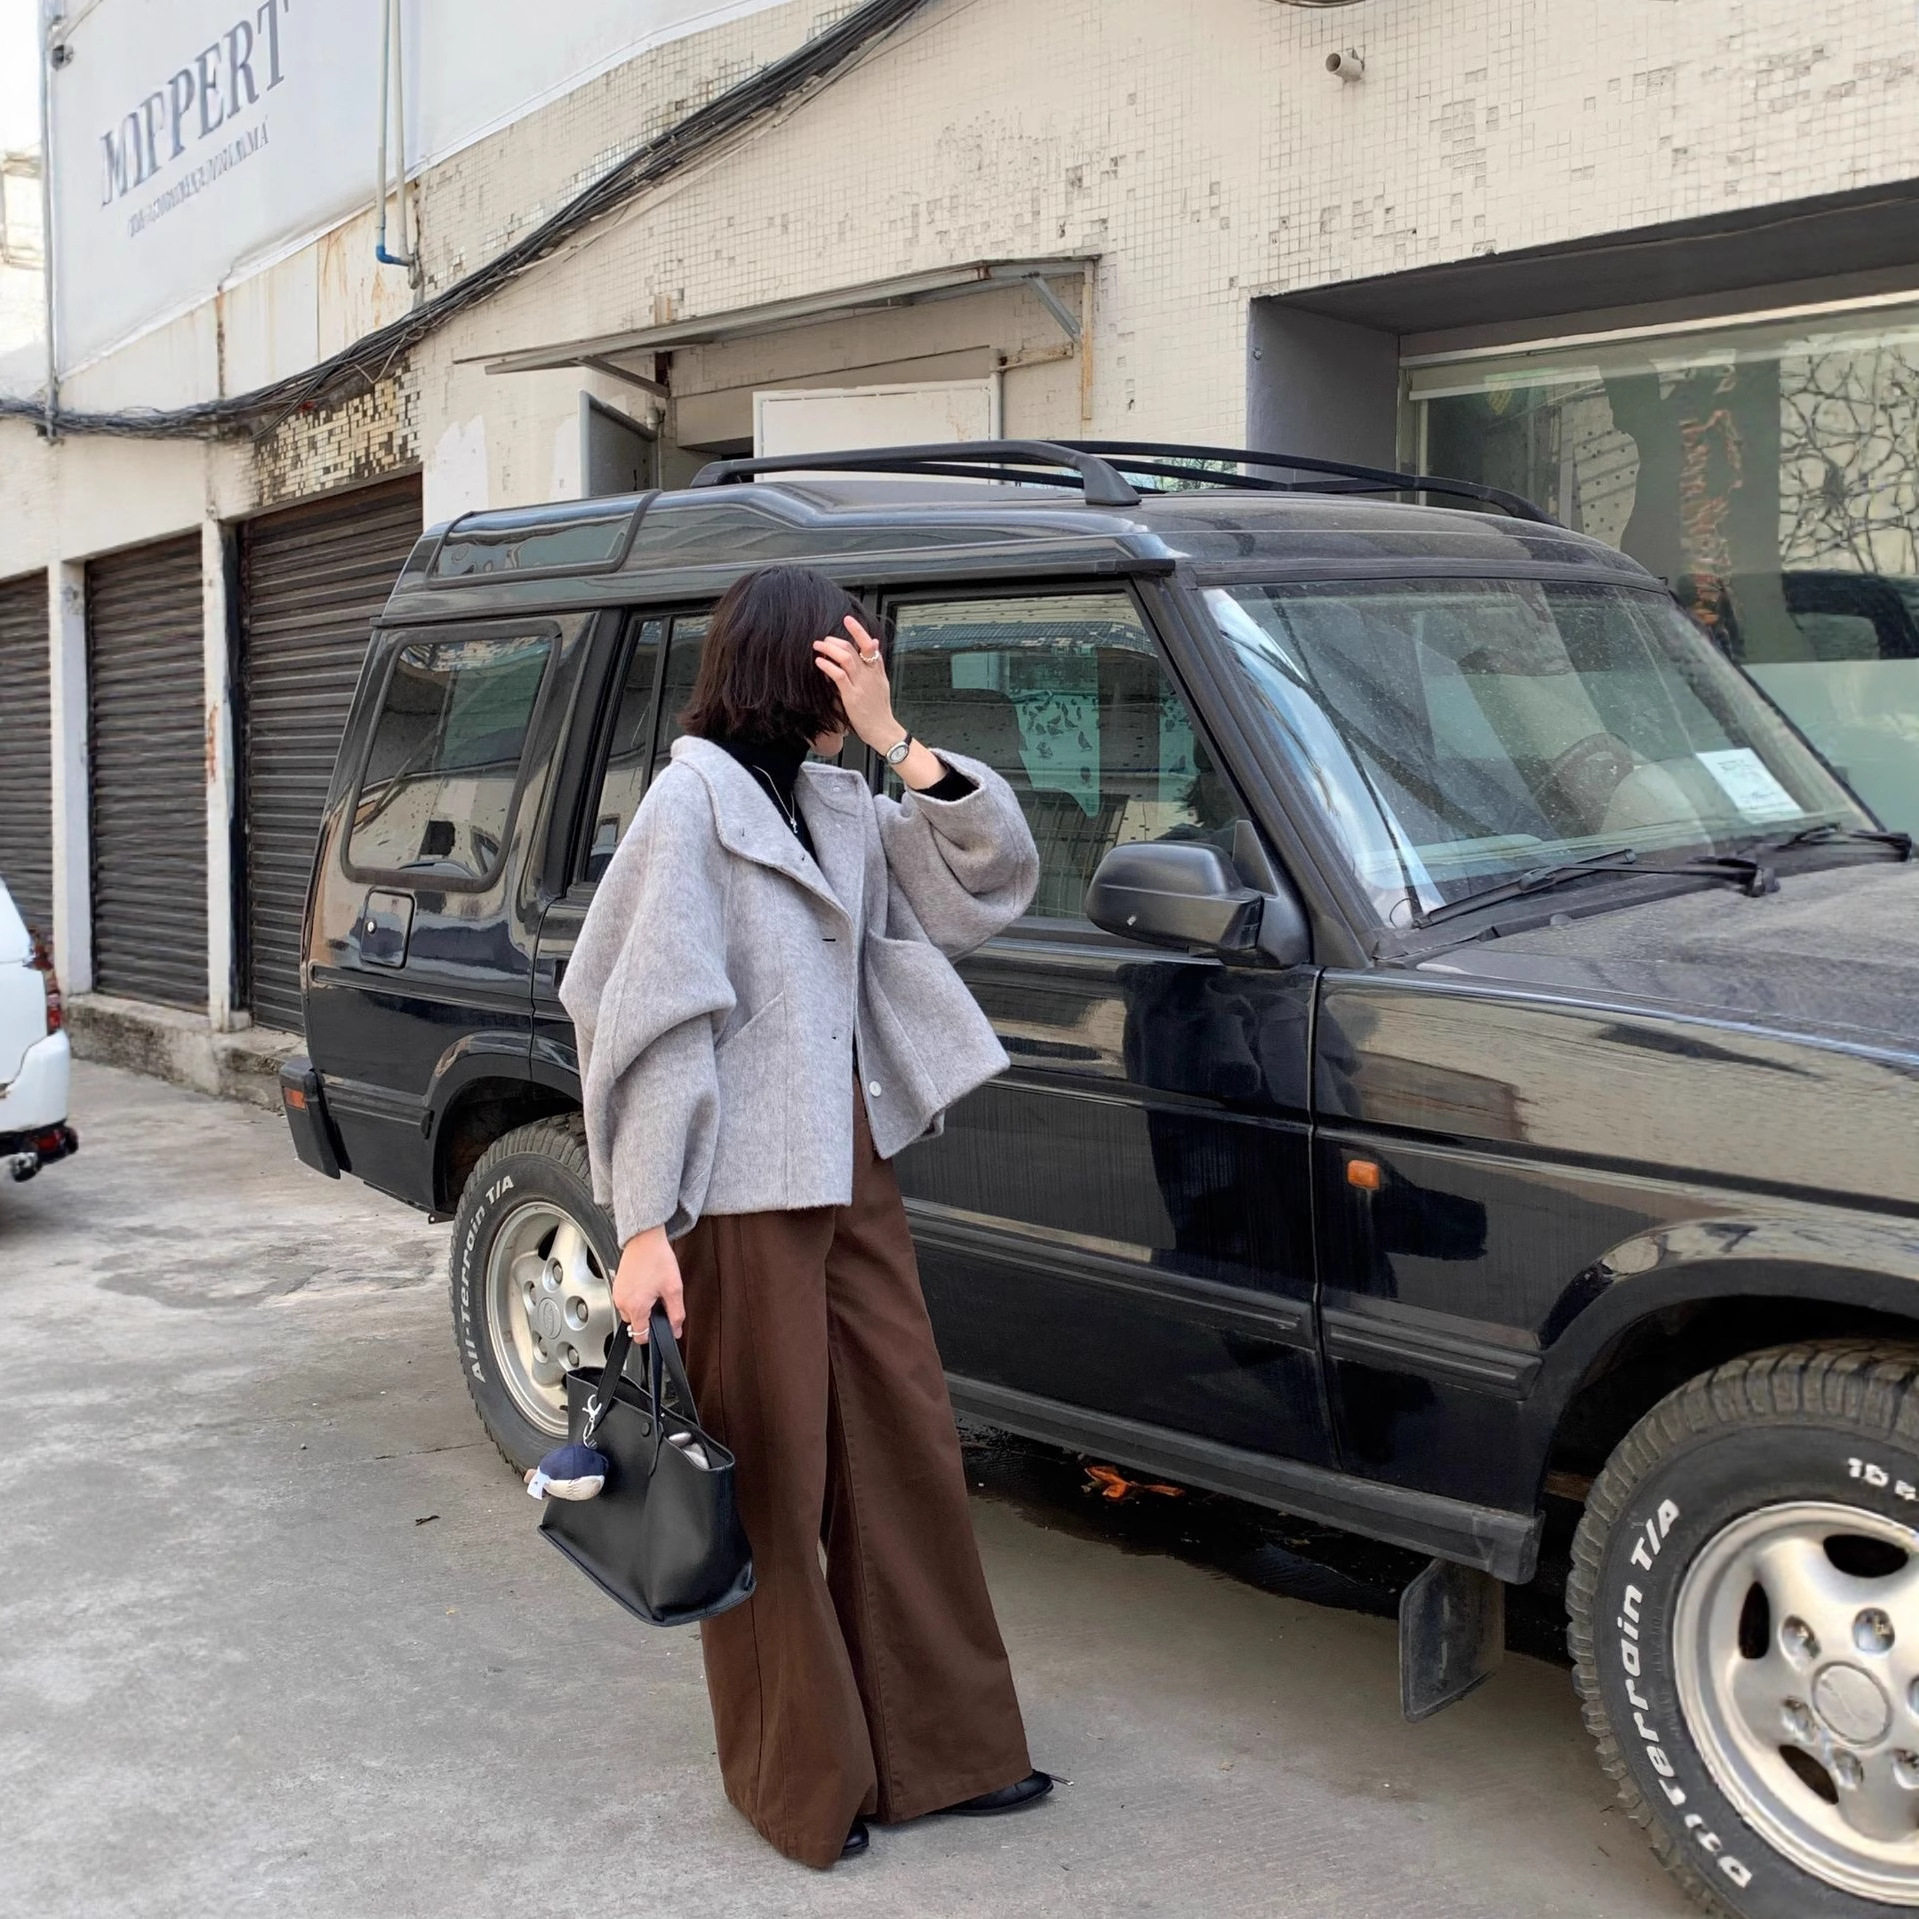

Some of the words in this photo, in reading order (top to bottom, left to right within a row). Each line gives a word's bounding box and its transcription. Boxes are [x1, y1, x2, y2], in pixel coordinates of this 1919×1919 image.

[459, 1206, 487, 1384] All-Terrain
[485, 1175, 515, 1205] T/A
[1630, 1498, 1680, 1571] T/A
